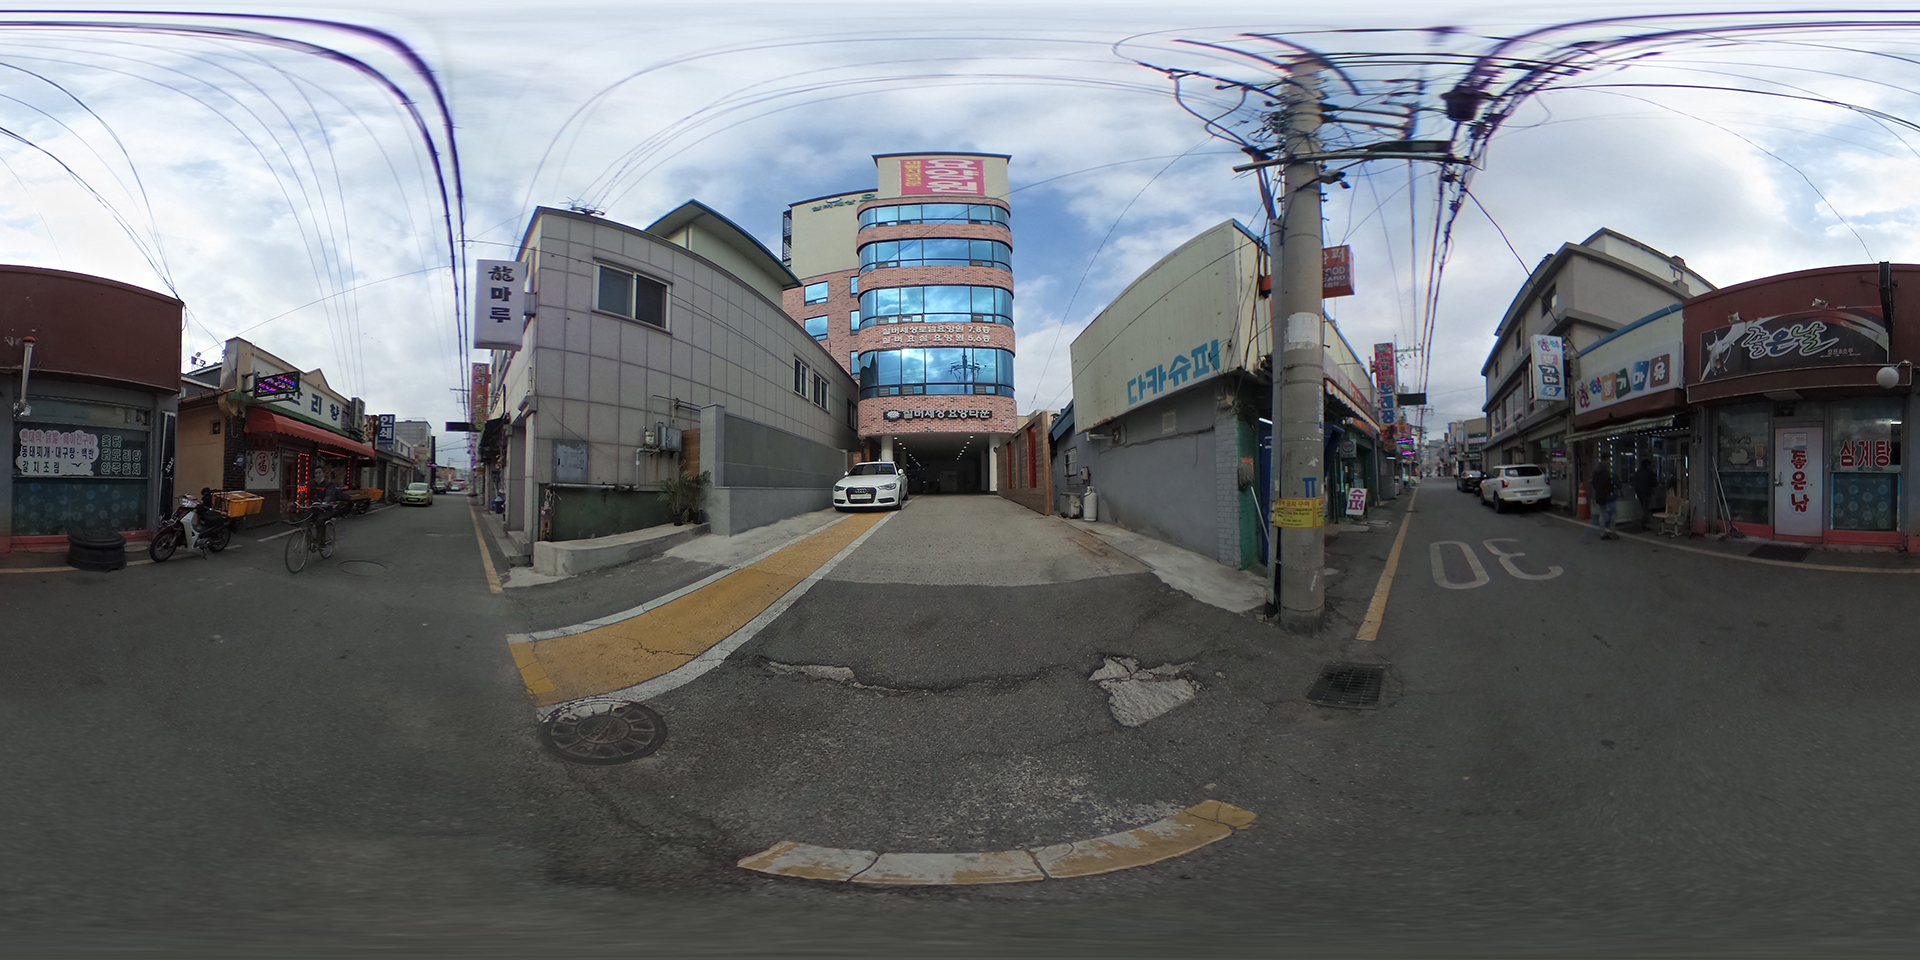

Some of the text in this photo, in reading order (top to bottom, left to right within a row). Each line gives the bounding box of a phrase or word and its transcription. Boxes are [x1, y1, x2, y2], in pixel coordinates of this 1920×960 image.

[925, 158, 979, 194] 요양원
[487, 265, 515, 323] 龍마루
[1742, 321, 1840, 359] 좋은날
[1127, 339, 1220, 405] 다카슈퍼
[379, 415, 393, 439] 인쇄
[903, 408, 990, 419] 실버세상 요양타운
[1840, 439, 1892, 468] 삼계탕
[1347, 489, 1364, 511] 슈퍼
[1790, 450, 1810, 513] 좋은날
[1429, 538, 1564, 589] 30
